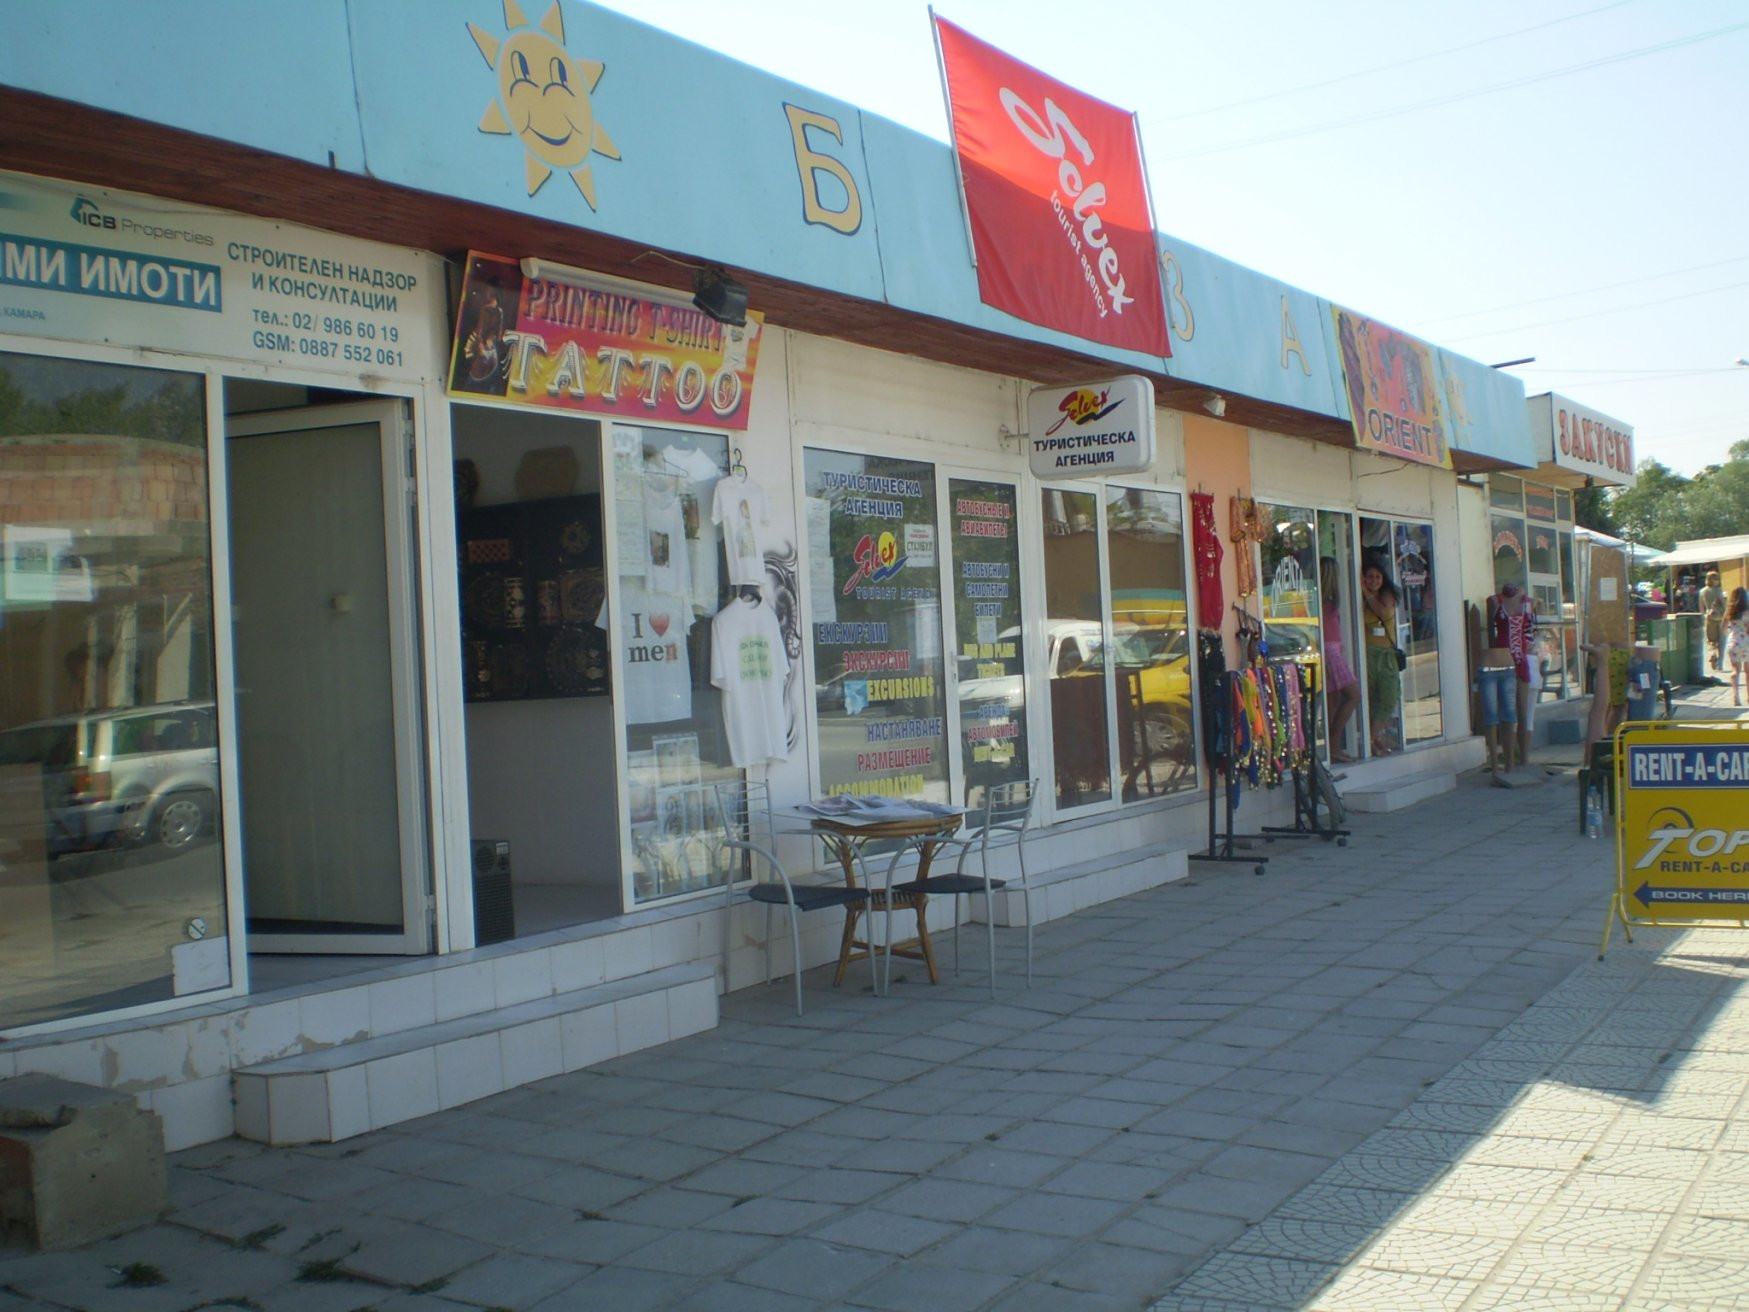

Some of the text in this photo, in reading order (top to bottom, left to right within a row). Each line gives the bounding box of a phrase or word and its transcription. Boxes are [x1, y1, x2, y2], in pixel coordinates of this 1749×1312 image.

[81, 211, 214, 247] ICB Properties
[228, 242, 417, 292] СТРОИТЕЛЕН НАДЗОР
[1051, 189, 1109, 318] tourist agency
[0, 241, 217, 306] МИ ИМОТИ
[252, 273, 398, 314] И КОНСУЛТАЦИИ
[523, 278, 642, 337] PRINTING
[323, 316, 353, 336] 986
[356, 321, 376, 340] 60
[380, 325, 399, 343] 19
[253, 331, 403, 367] GSM: 0887 552 061
[500, 330, 743, 416] TATTOO
[1033, 430, 1136, 452] ТУРИСТИЧЕСКА
[1367, 407, 1432, 458] ORIENT
[1558, 408, 1633, 476] ЗАКУСКИ
[1055, 451, 1115, 468] АГЕНЦИЯ
[823, 471, 922, 498] ТУРИСТИЧЕСКА
[845, 497, 904, 520] АГЕНЦИЯ
[631, 613, 643, 638] I
[817, 622, 888, 645] ЕКСКУРЗИИ
[628, 642, 678, 663] men
[842, 650, 910, 673] ЭКСКУРСИИ
[867, 676, 935, 702] EXCURSIONS
[866, 717, 942, 742] НАСТАНЯВАНЕ
[856, 746, 931, 772] РАЗМЕЩЕНИЕ
[1652, 891, 1704, 900] BOOK
